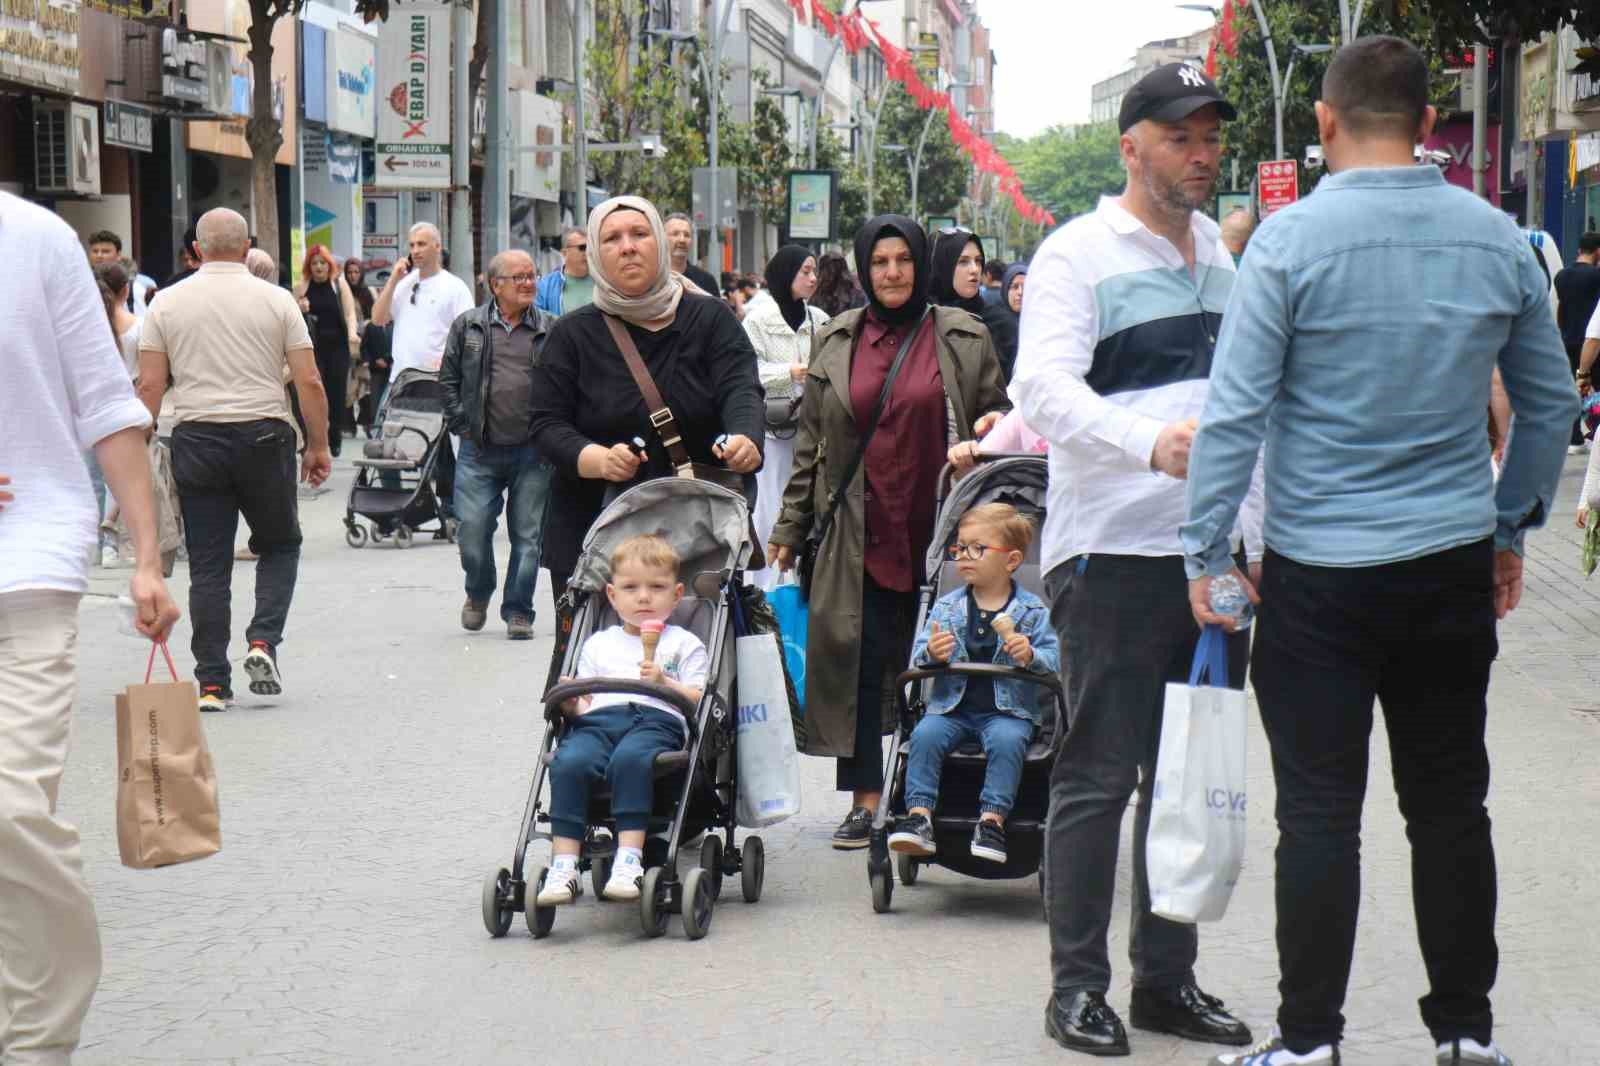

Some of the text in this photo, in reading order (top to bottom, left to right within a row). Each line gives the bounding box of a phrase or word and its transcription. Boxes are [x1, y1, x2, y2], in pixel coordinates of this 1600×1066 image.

[1178, 67, 1206, 87] NY
[386, 144, 442, 153] ORHAN USTA
[412, 160, 427, 169] 100
[149, 710, 165, 826] www.superstep.com
